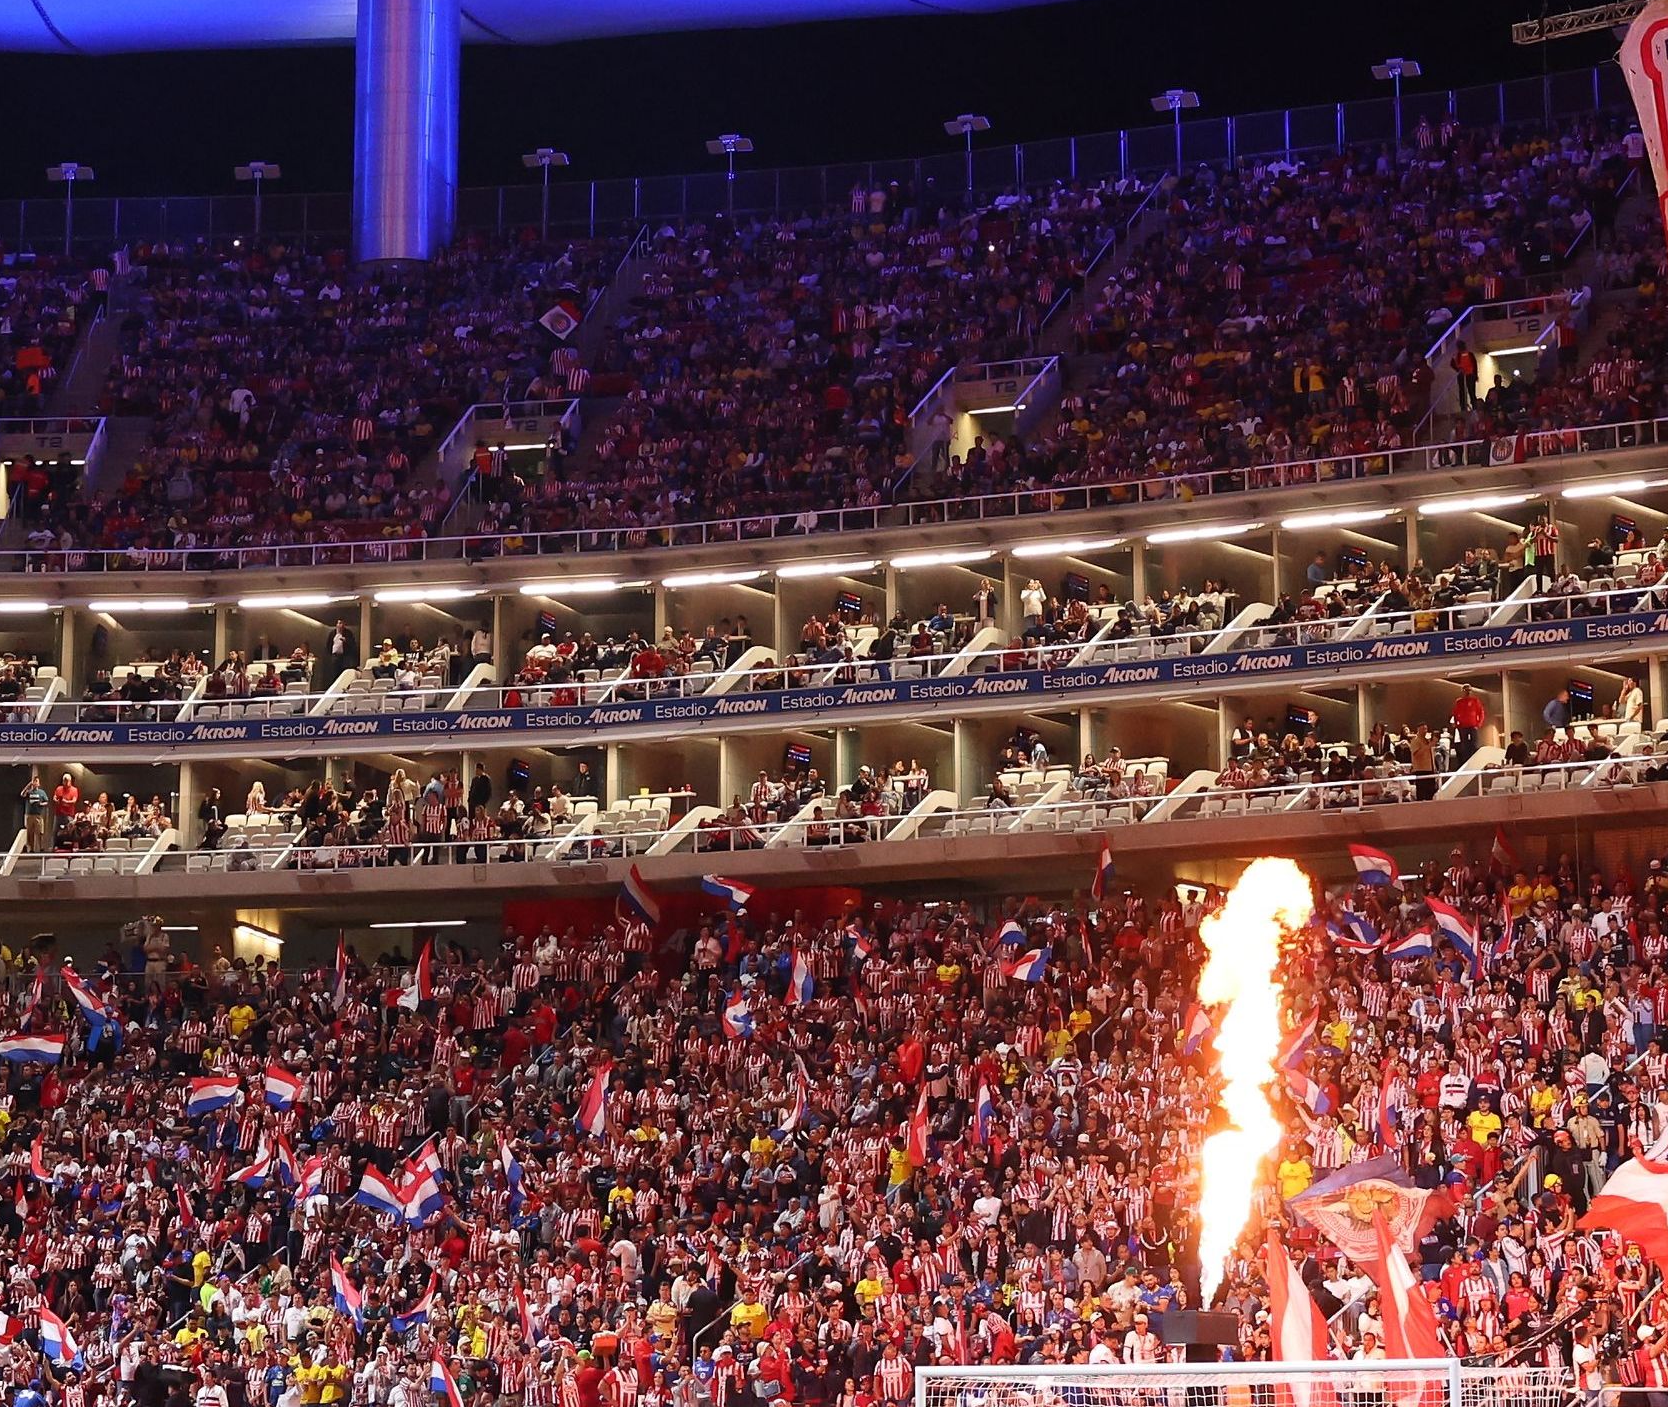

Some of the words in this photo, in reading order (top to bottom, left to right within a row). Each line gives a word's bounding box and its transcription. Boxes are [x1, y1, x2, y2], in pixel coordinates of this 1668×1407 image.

[1515, 319, 1540, 332] T2
[992, 381, 1018, 393] T2
[35, 437, 62, 448] T2
[1586, 619, 1646, 639] Estadio
[1444, 633, 1503, 652] Estadio
[1506, 628, 1571, 646] AKRON
[1306, 645, 1364, 665] Estadio
[1366, 641, 1430, 662] AKRON
[1173, 657, 1228, 677] Estadio
[1231, 653, 1292, 673] AKRON
[1042, 671, 1097, 689] Estadio
[1099, 666, 1159, 684] AKRON
[910, 681, 964, 700] Estadio
[967, 677, 1028, 695] AKRON
[781, 692, 834, 710] Estadio
[837, 688, 896, 705] AKRON
[526, 710, 581, 727] Estadio
[584, 708, 642, 725] AKRON
[655, 702, 707, 719] Estadio
[710, 699, 767, 715] AKRON
[262, 723, 316, 738] Estadio
[318, 719, 379, 736] AKRON
[393, 716, 448, 732] Estadio
[450, 714, 512, 730] AKRON
[50, 727, 113, 742] AKRON
[129, 727, 185, 742] Estadio
[186, 725, 247, 740] AKRON
